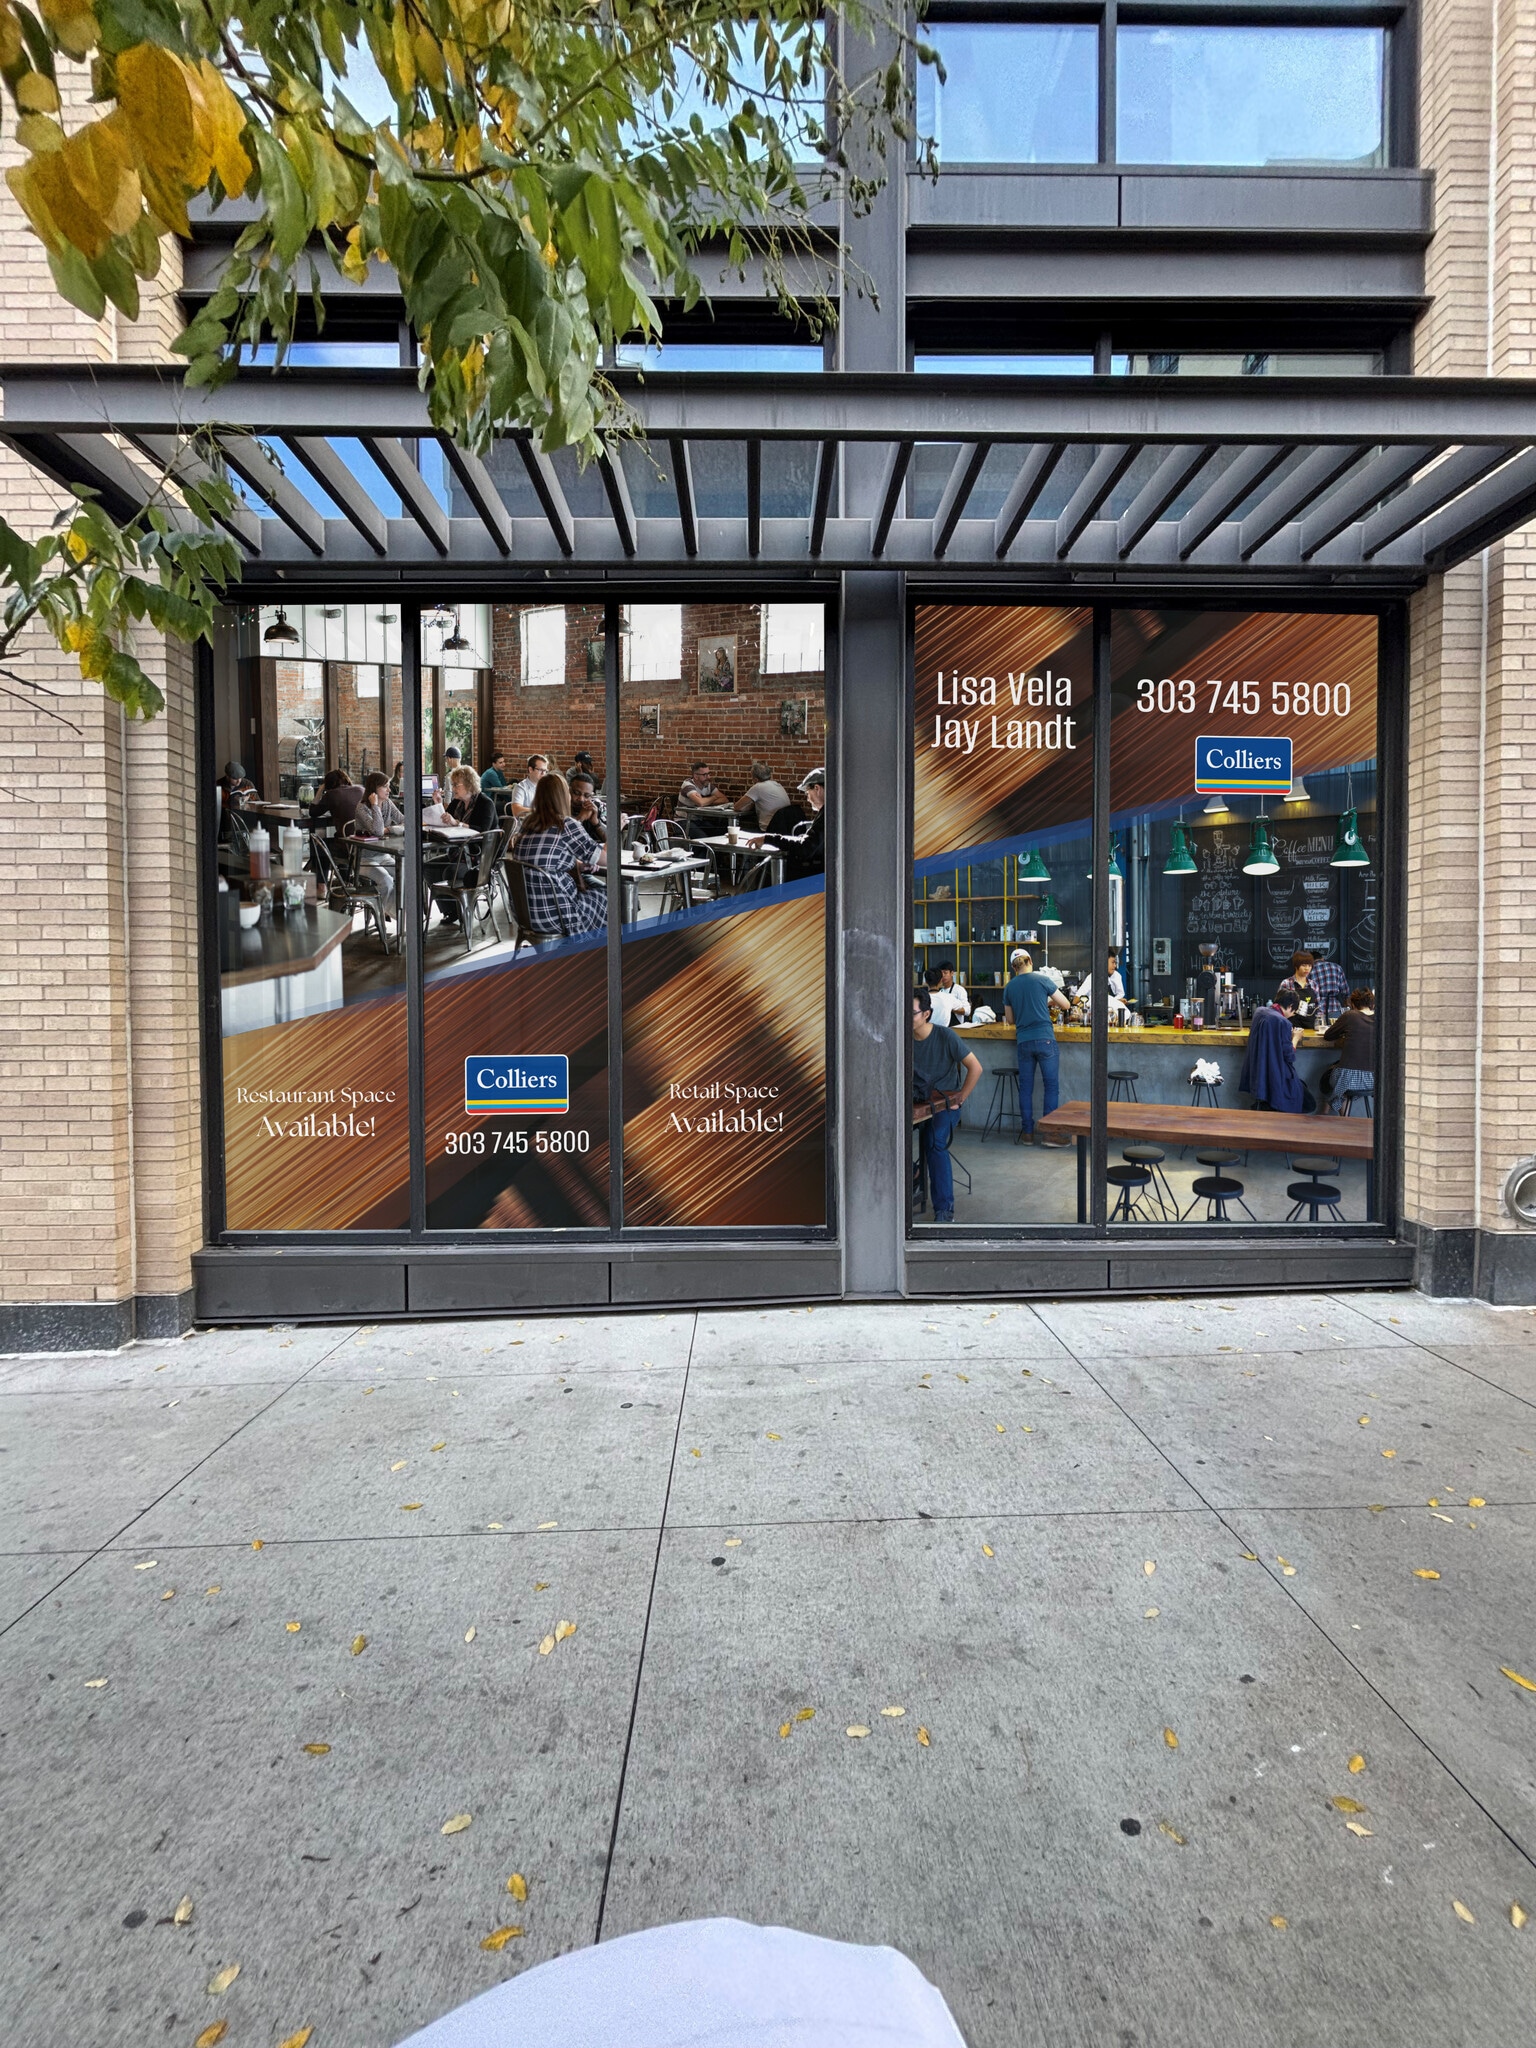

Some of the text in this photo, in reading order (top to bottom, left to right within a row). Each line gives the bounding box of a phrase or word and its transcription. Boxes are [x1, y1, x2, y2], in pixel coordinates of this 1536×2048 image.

[937, 669, 1072, 707] Lisa Vela
[1136, 678, 1351, 717] 303 745 5800
[930, 714, 1077, 755] Jay Landt
[1205, 748, 1282, 770] Colliers
[1307, 835, 1334, 853] MENU
[476, 1068, 558, 1089] Colliers
[236, 1087, 396, 1108] Restaurant Space
[669, 1081, 780, 1104] Retail Space
[256, 1113, 376, 1138] Available!
[663, 1108, 784, 1133] Available!
[444, 1130, 590, 1155] 303 745 5800
